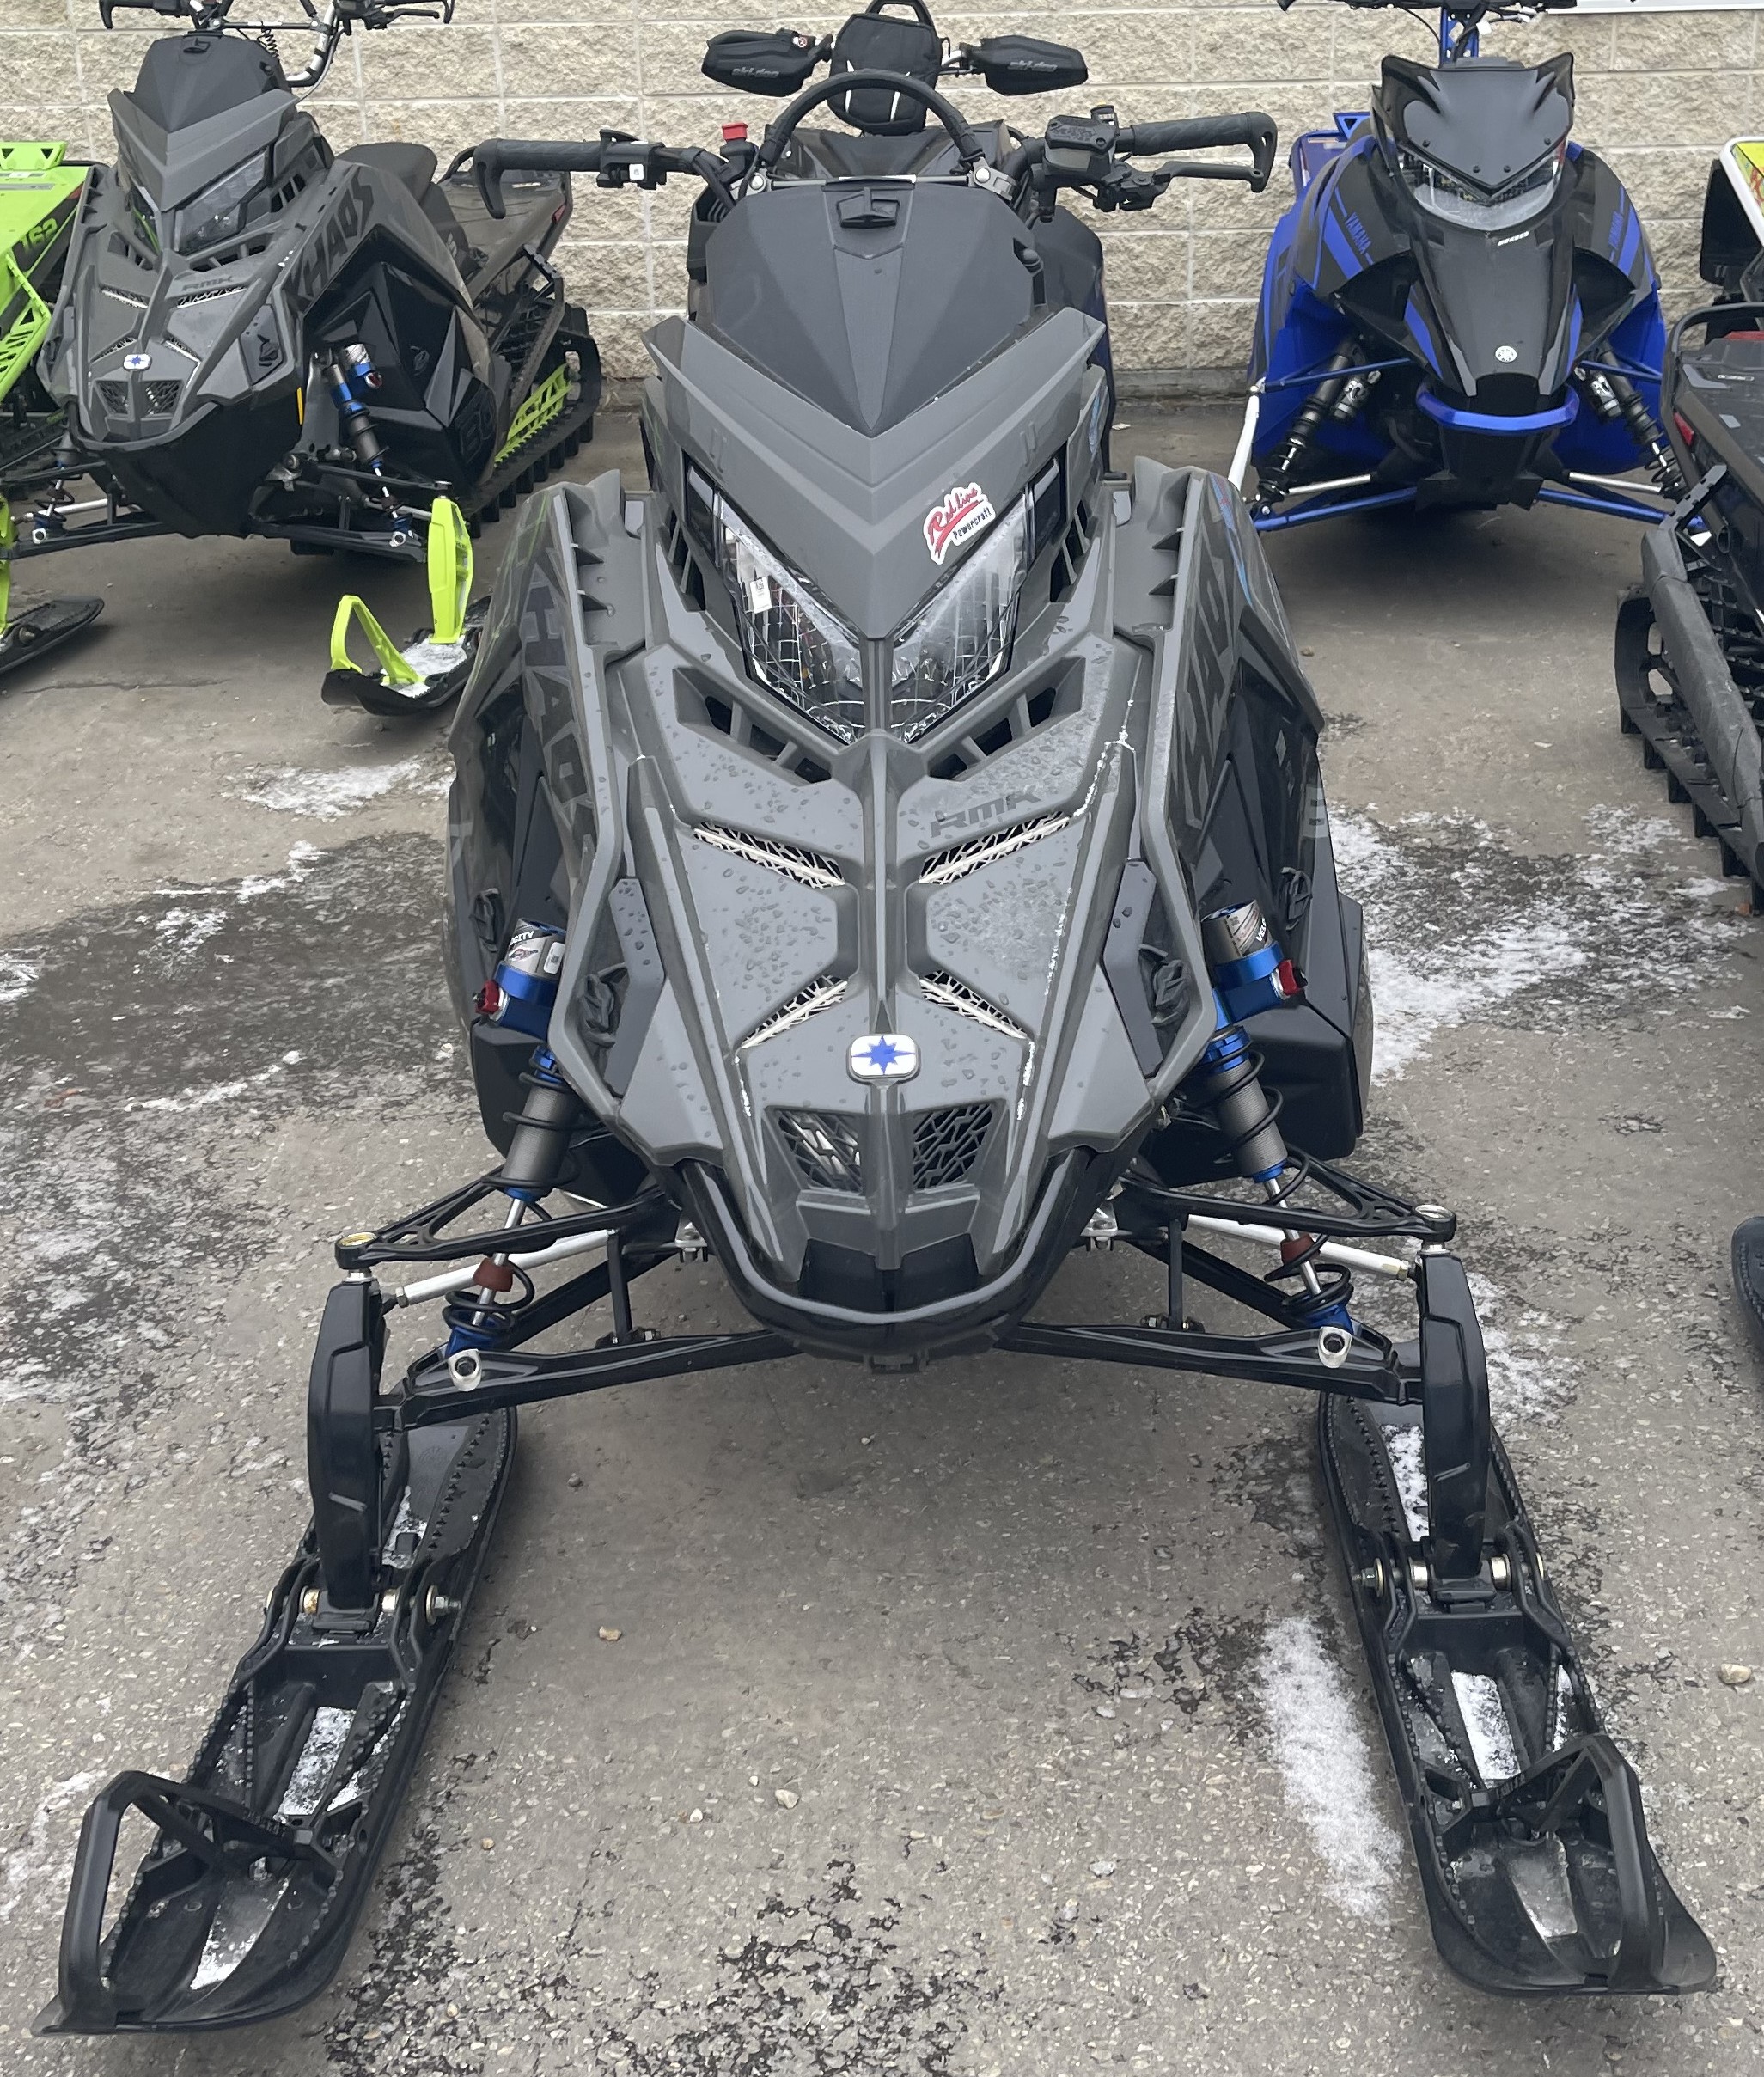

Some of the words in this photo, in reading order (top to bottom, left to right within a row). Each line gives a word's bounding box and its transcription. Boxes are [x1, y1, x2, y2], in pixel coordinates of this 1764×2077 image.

[282, 167, 374, 315] KHAOS
[1345, 211, 1372, 255] YAMAHA
[181, 274, 235, 292] RMK
[952, 506, 992, 541] Powercraft
[931, 792, 1041, 839] RMK
